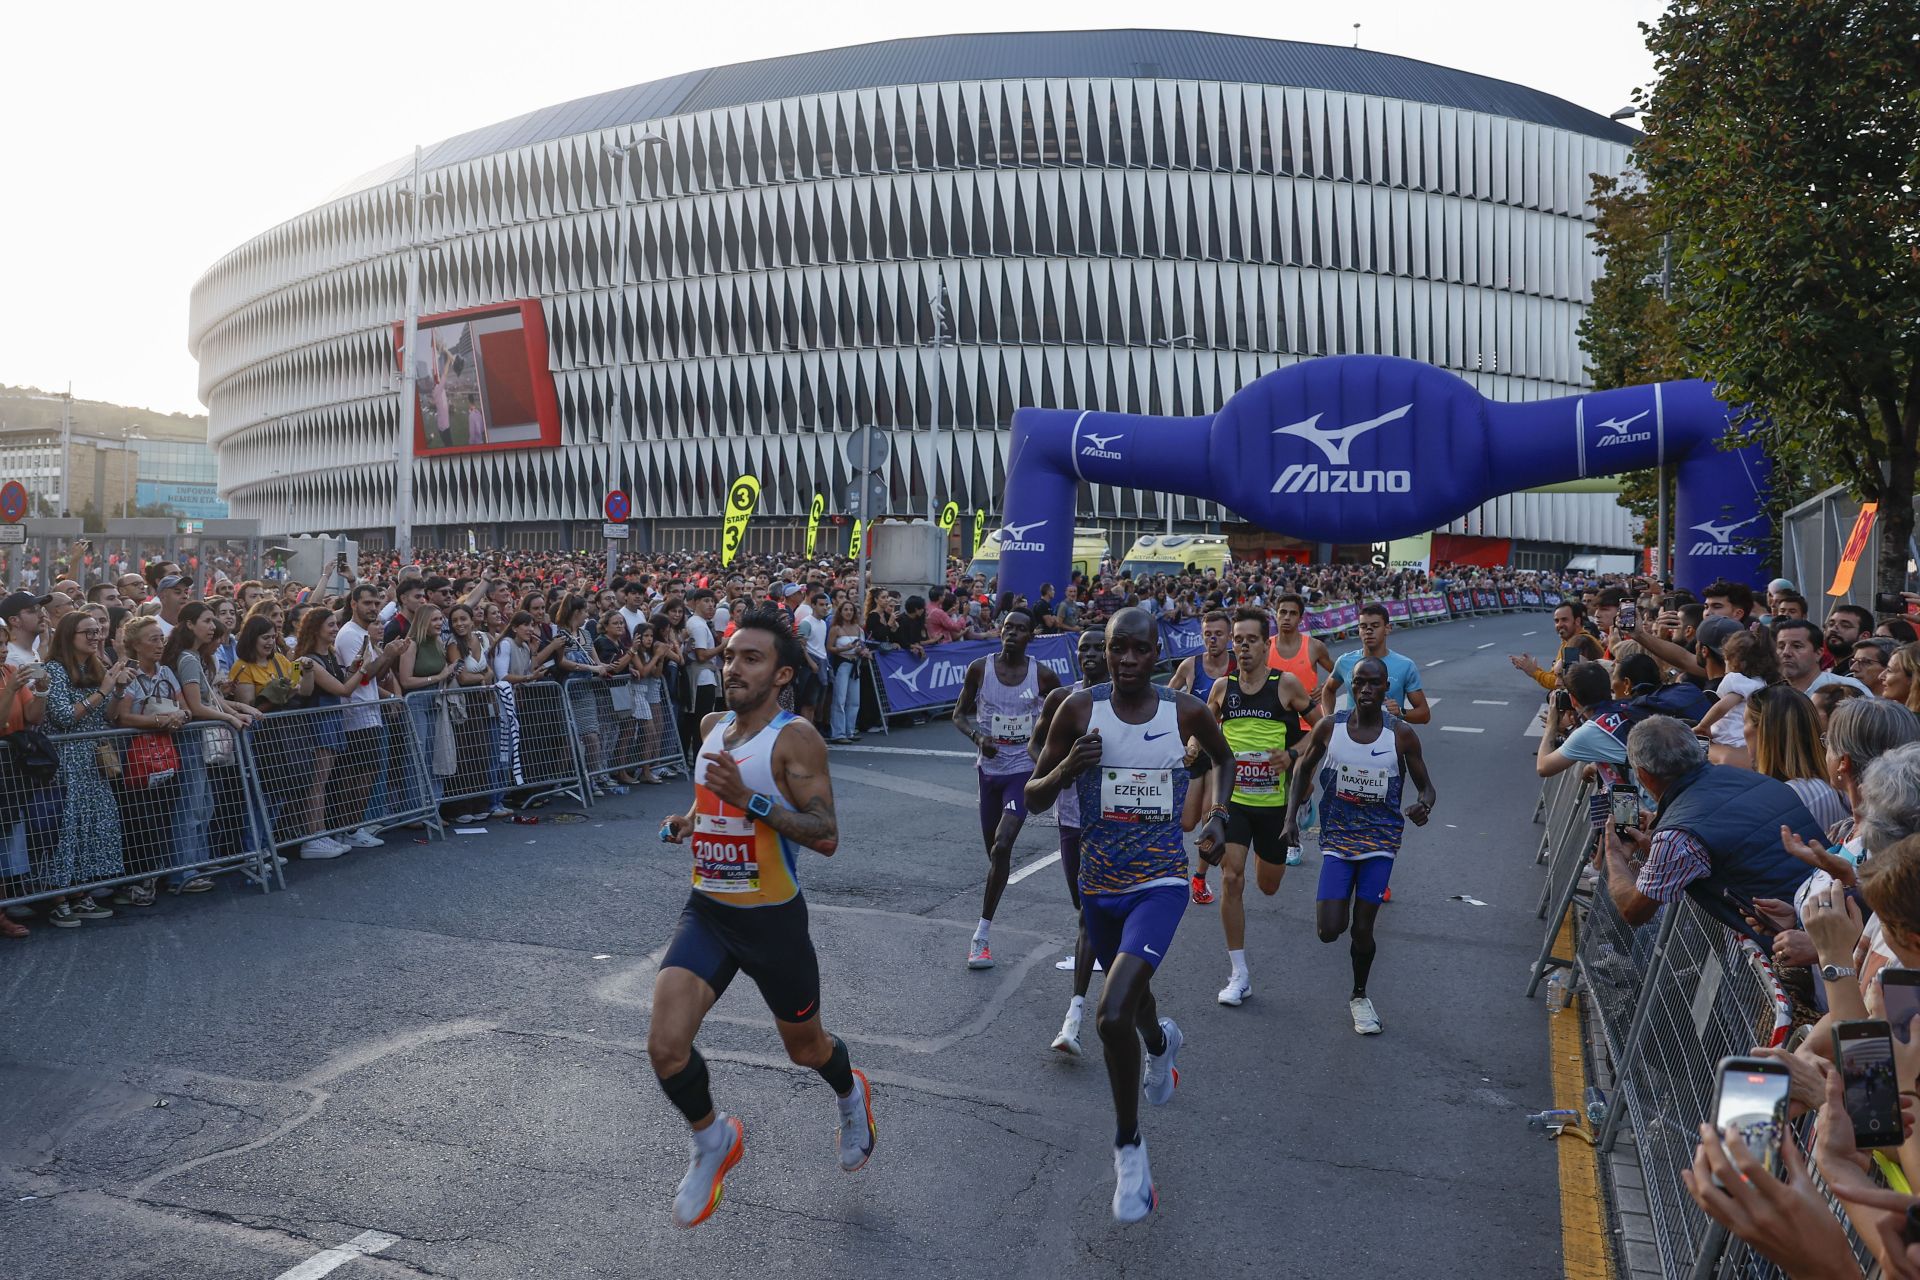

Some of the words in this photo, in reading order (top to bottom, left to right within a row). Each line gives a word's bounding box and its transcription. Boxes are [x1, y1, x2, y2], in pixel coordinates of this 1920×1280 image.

[1596, 432, 1651, 447] MIZUNO
[1081, 446, 1122, 460] MIZUNO
[1270, 464, 1411, 493] MIZUNO
[737, 487, 750, 507] 3
[726, 513, 750, 524] START
[946, 509, 953, 524] 6
[726, 525, 739, 551] 3
[851, 537, 860, 556] 5
[1001, 540, 1045, 552] MIZUNO
[1229, 709, 1272, 719] DURANGO
[1605, 713, 1621, 728] 27
[1236, 765, 1276, 778] 20045
[1341, 774, 1385, 787] MAXWELL
[1114, 784, 1162, 796] EZEKIEL
[1136, 798, 1141, 806] 1
[696, 841, 749, 861] 20001
